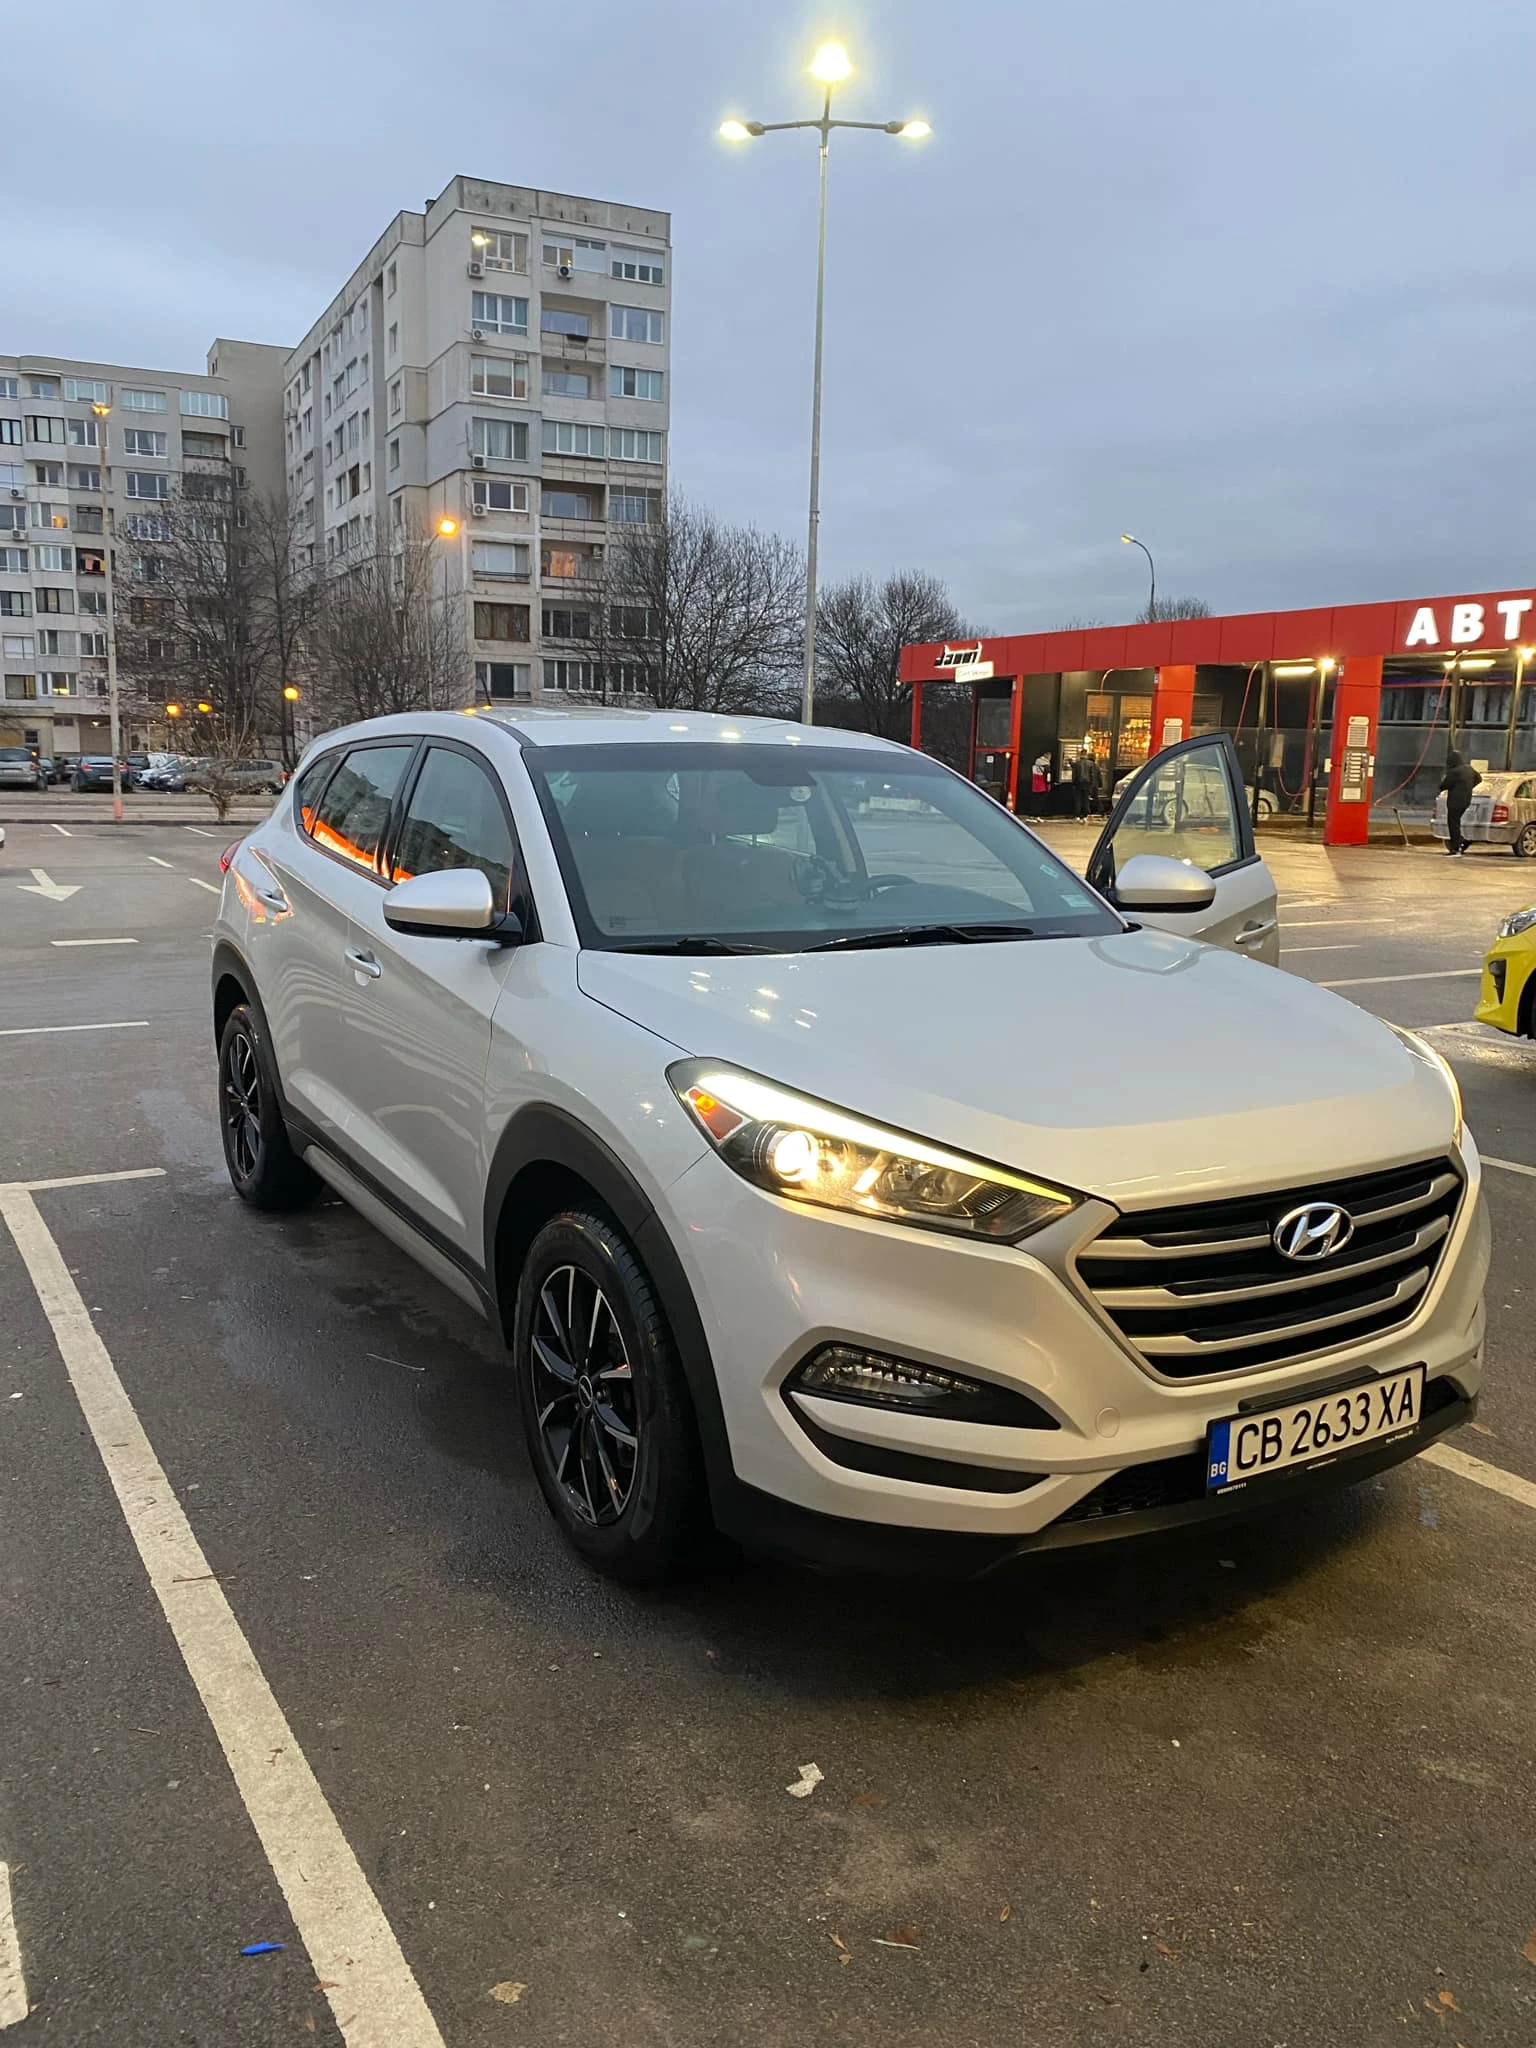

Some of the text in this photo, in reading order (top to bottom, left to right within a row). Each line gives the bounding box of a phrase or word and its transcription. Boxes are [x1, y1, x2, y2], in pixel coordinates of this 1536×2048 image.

[1236, 1377, 1414, 1470] CB 2633 XA
[1211, 1461, 1227, 1478] BG
